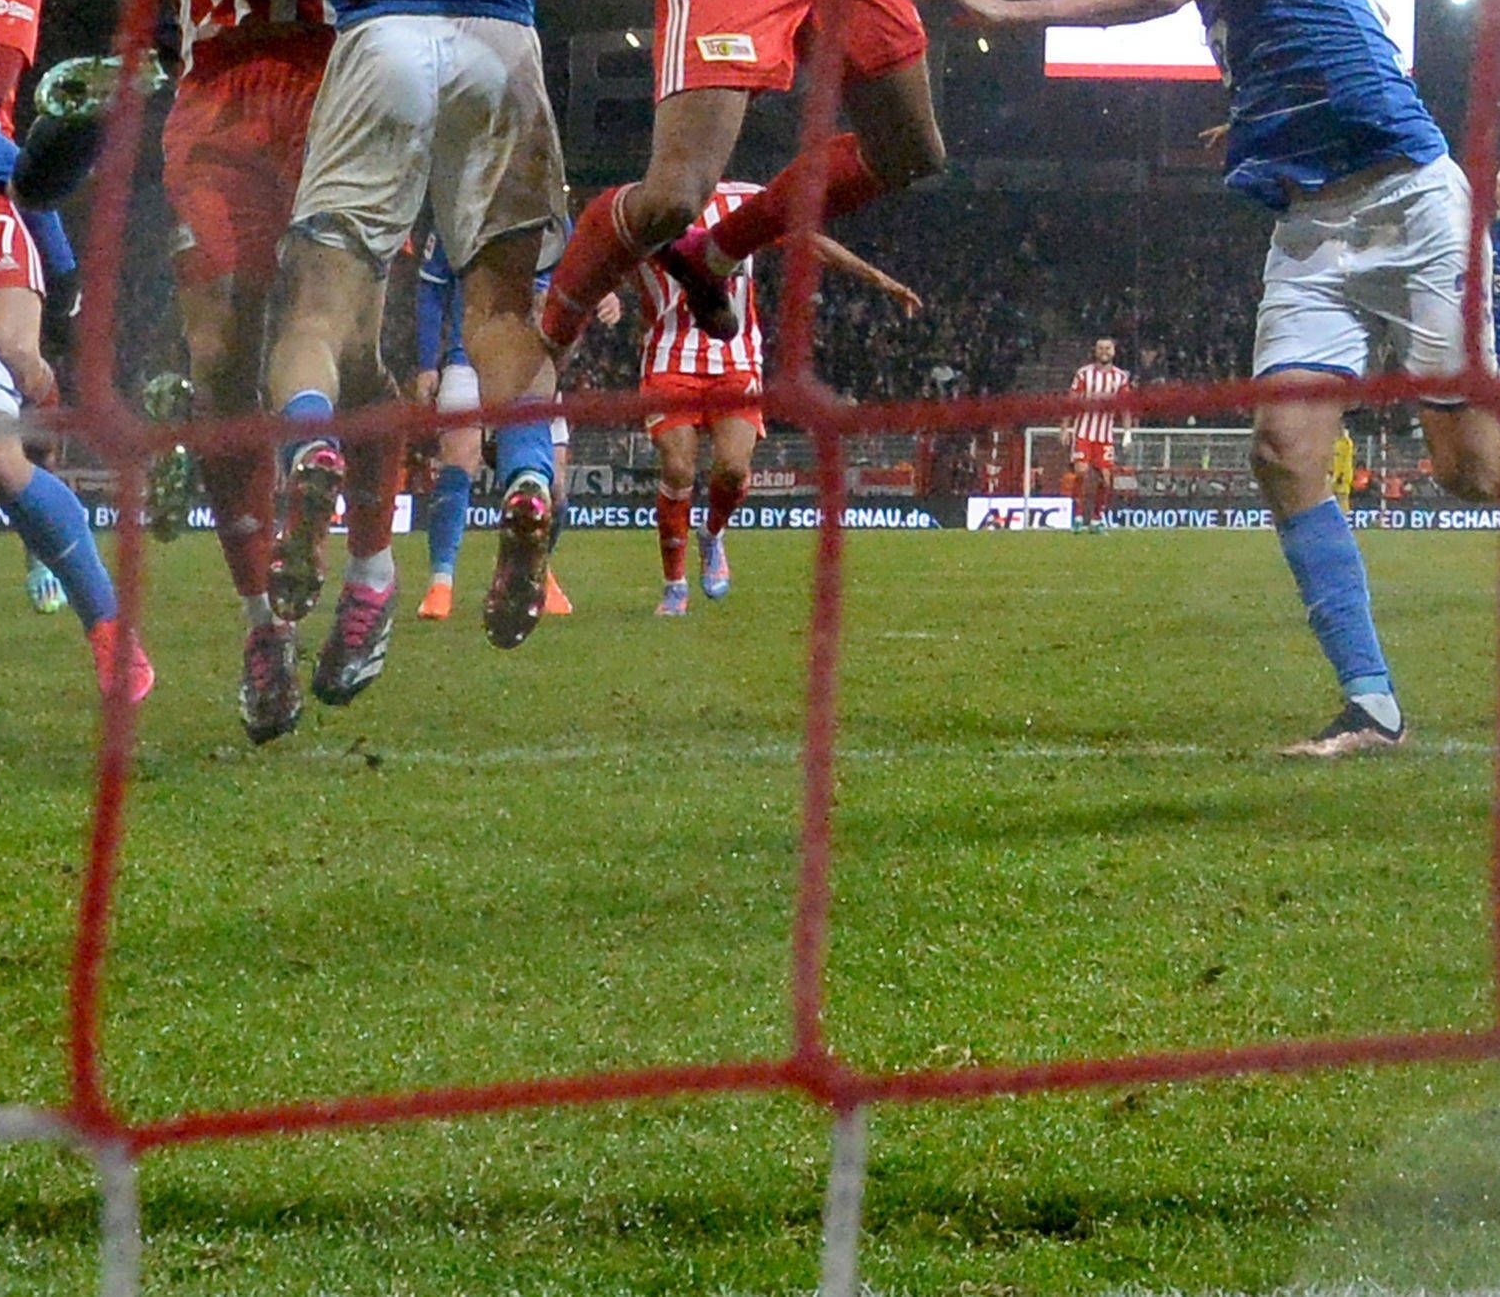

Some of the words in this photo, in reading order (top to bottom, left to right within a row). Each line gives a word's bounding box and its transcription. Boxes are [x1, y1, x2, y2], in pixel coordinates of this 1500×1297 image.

[95, 507, 119, 526] BY
[568, 507, 630, 526] TAPES
[760, 509, 787, 527] BY
[980, 507, 1063, 531] AFTC
[1099, 509, 1218, 529] AUTOMOTIVE
[1224, 510, 1273, 529] TAPE
[1410, 510, 1435, 529] BY
